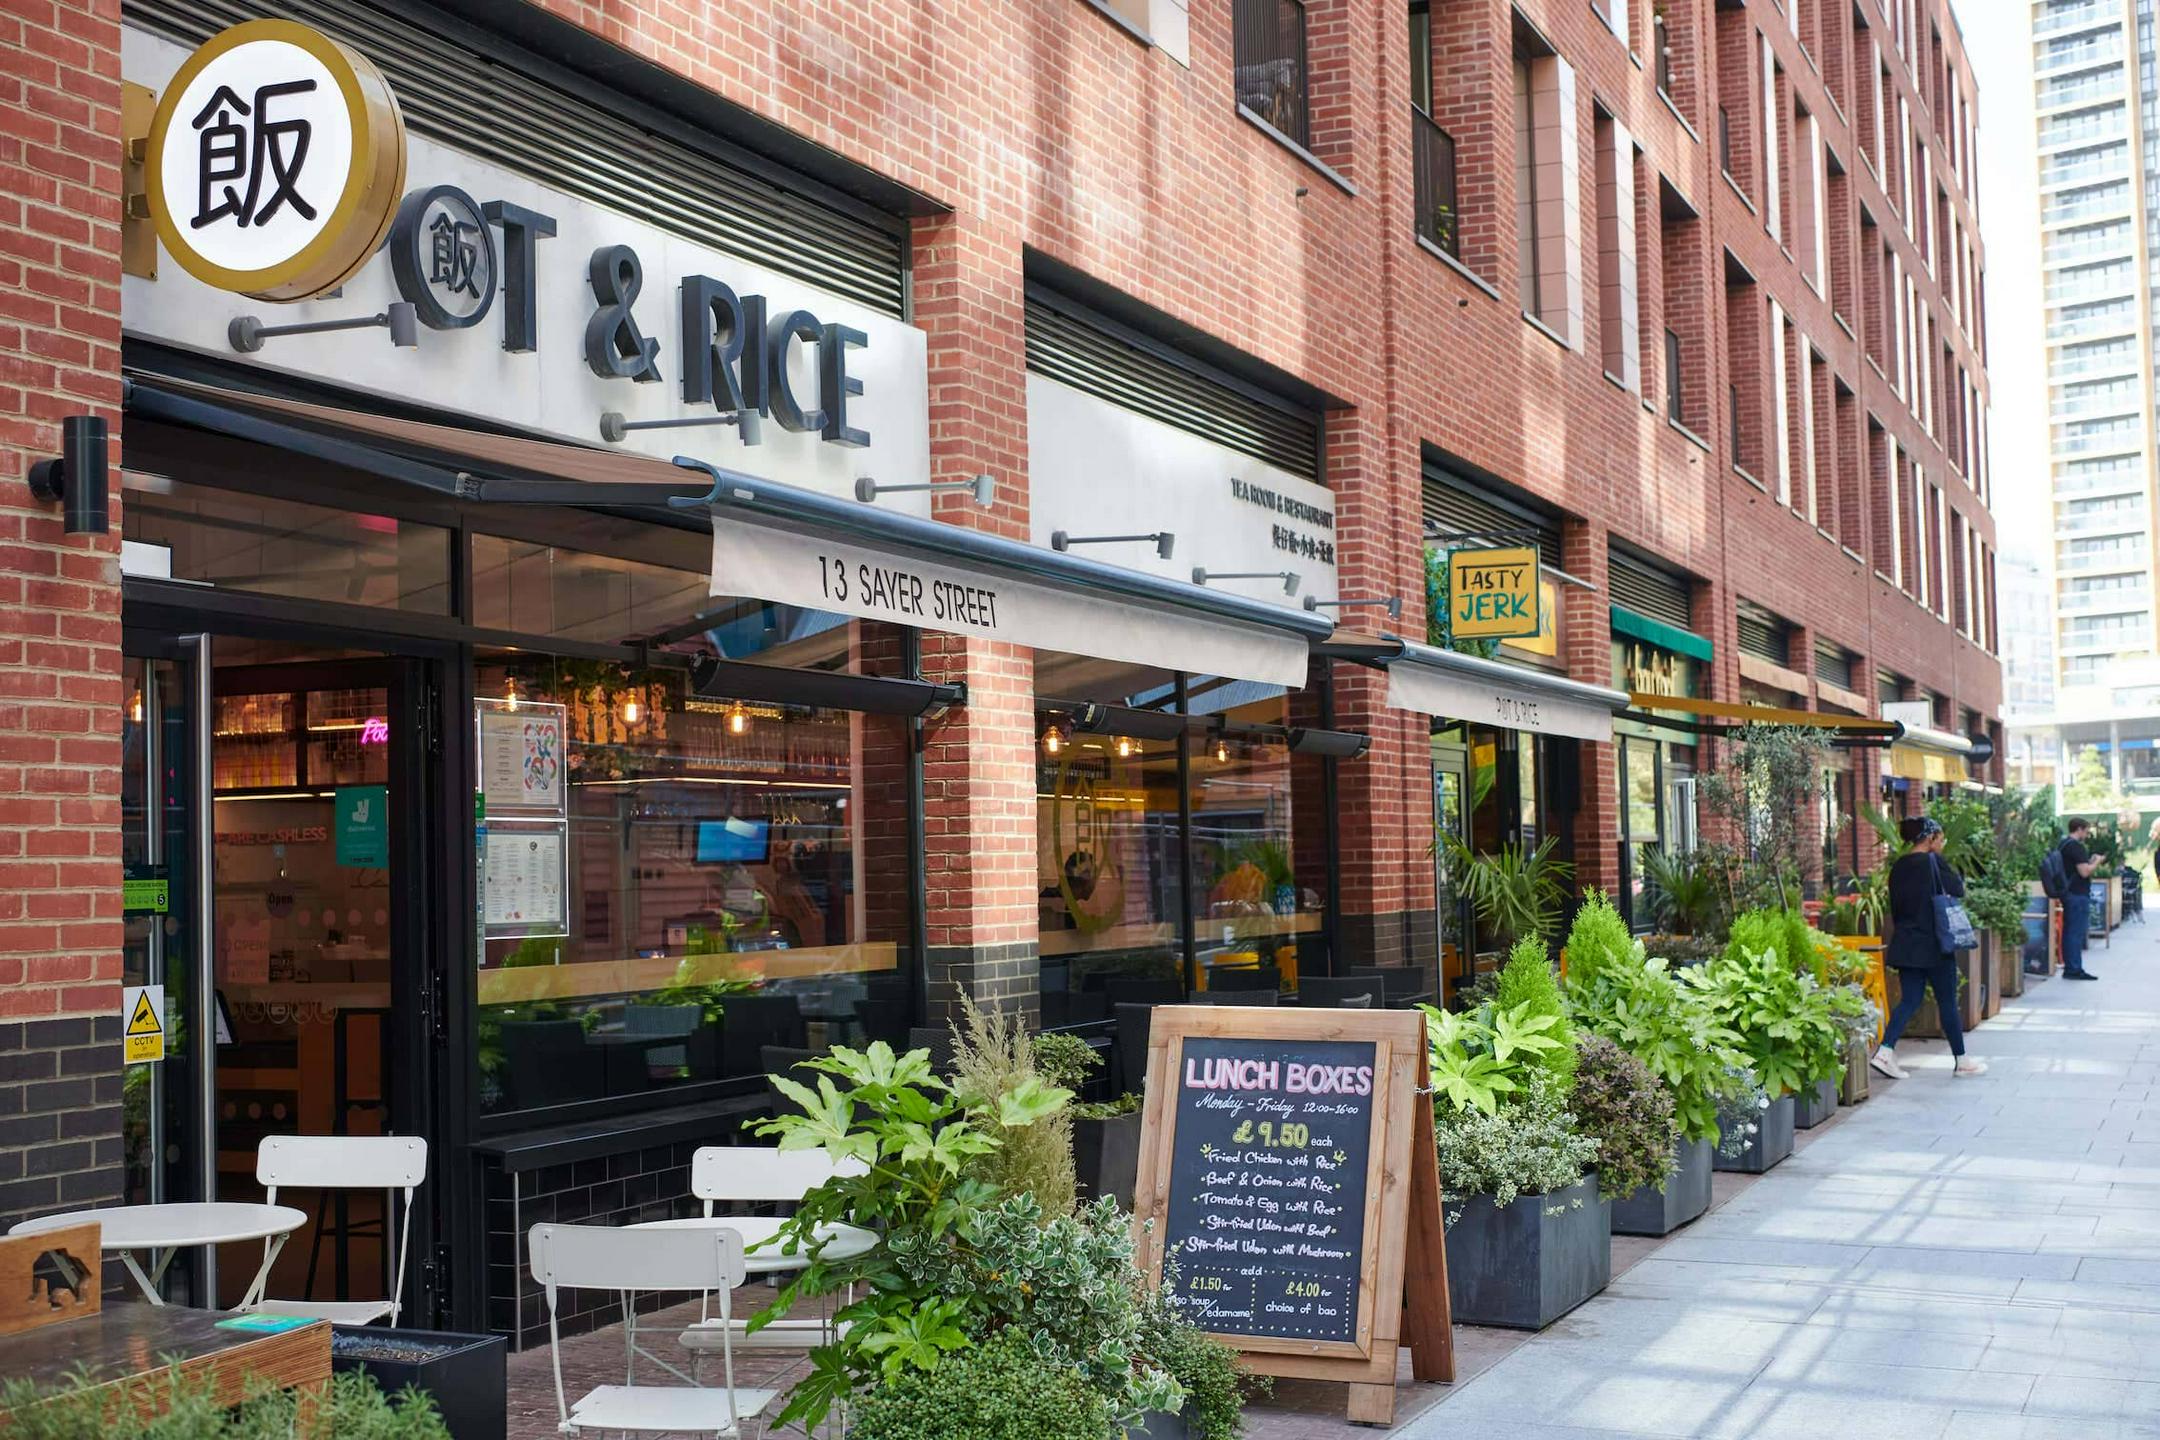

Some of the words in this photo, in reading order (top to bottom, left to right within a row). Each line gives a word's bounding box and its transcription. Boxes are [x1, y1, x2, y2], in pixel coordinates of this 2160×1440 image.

[191, 79, 317, 229] 飯
[586, 244, 664, 384] &
[681, 274, 870, 449] RICE
[1231, 478, 1249, 502] TEA
[1250, 484, 1276, 511] ROOM
[1277, 494, 1284, 513] &
[1284, 496, 1333, 530] RESTAURANT
[1457, 563, 1525, 591] TASTY
[819, 556, 848, 602] 13
[859, 564, 924, 616] SAYER
[933, 579, 997, 628] STREET
[1459, 592, 1530, 622] JERK
[134, 1036, 154, 1046] CCTV
[1185, 1058, 1280, 1090] LUNCH
[1285, 1063, 1373, 1096] BOXES
[1195, 1092, 1243, 1117] Monday
[1232, 1119, 1309, 1148] £9.50
[1311, 1135, 1332, 1147] each
[1208, 1148, 1240, 1163] Fried
[1245, 1152, 1282, 1165] Chicken
[1287, 1155, 1308, 1166] with
[1316, 1155, 1336, 1170] Rice
[1206, 1172, 1236, 1185] Beef
[1239, 1172, 1248, 1186] &
[1252, 1174, 1283, 1187] Onion
[1286, 1178, 1307, 1189] with
[1310, 1176, 1333, 1194] Rice
[1200, 1192, 1243, 1207] Tomato
[1245, 1195, 1254, 1207] &
[1258, 1197, 1279, 1213] Egg
[1286, 1201, 1308, 1212] with
[1313, 1200, 1336, 1216] Rice
[1257, 1218, 1281, 1232] Udon
[1284, 1221, 1304, 1233] with
[1307, 1224, 1331, 1238] Beef
[1242, 1239, 1267, 1255] Udon
[1273, 1243, 1295, 1255] with
[1298, 1244, 1343, 1259] Mushroom
[1240, 1266, 1262, 1276] add
[1190, 1276, 1221, 1291] £1.50
[1286, 1281, 1320, 1297] £4.00
[1321, 1289, 1332, 1297] for
[1207, 1307, 1251, 1318] edamame
[1265, 1301, 1294, 1313] choice
[1300, 1303, 1312, 1315] of
[1318, 1305, 1336, 1316] bao
